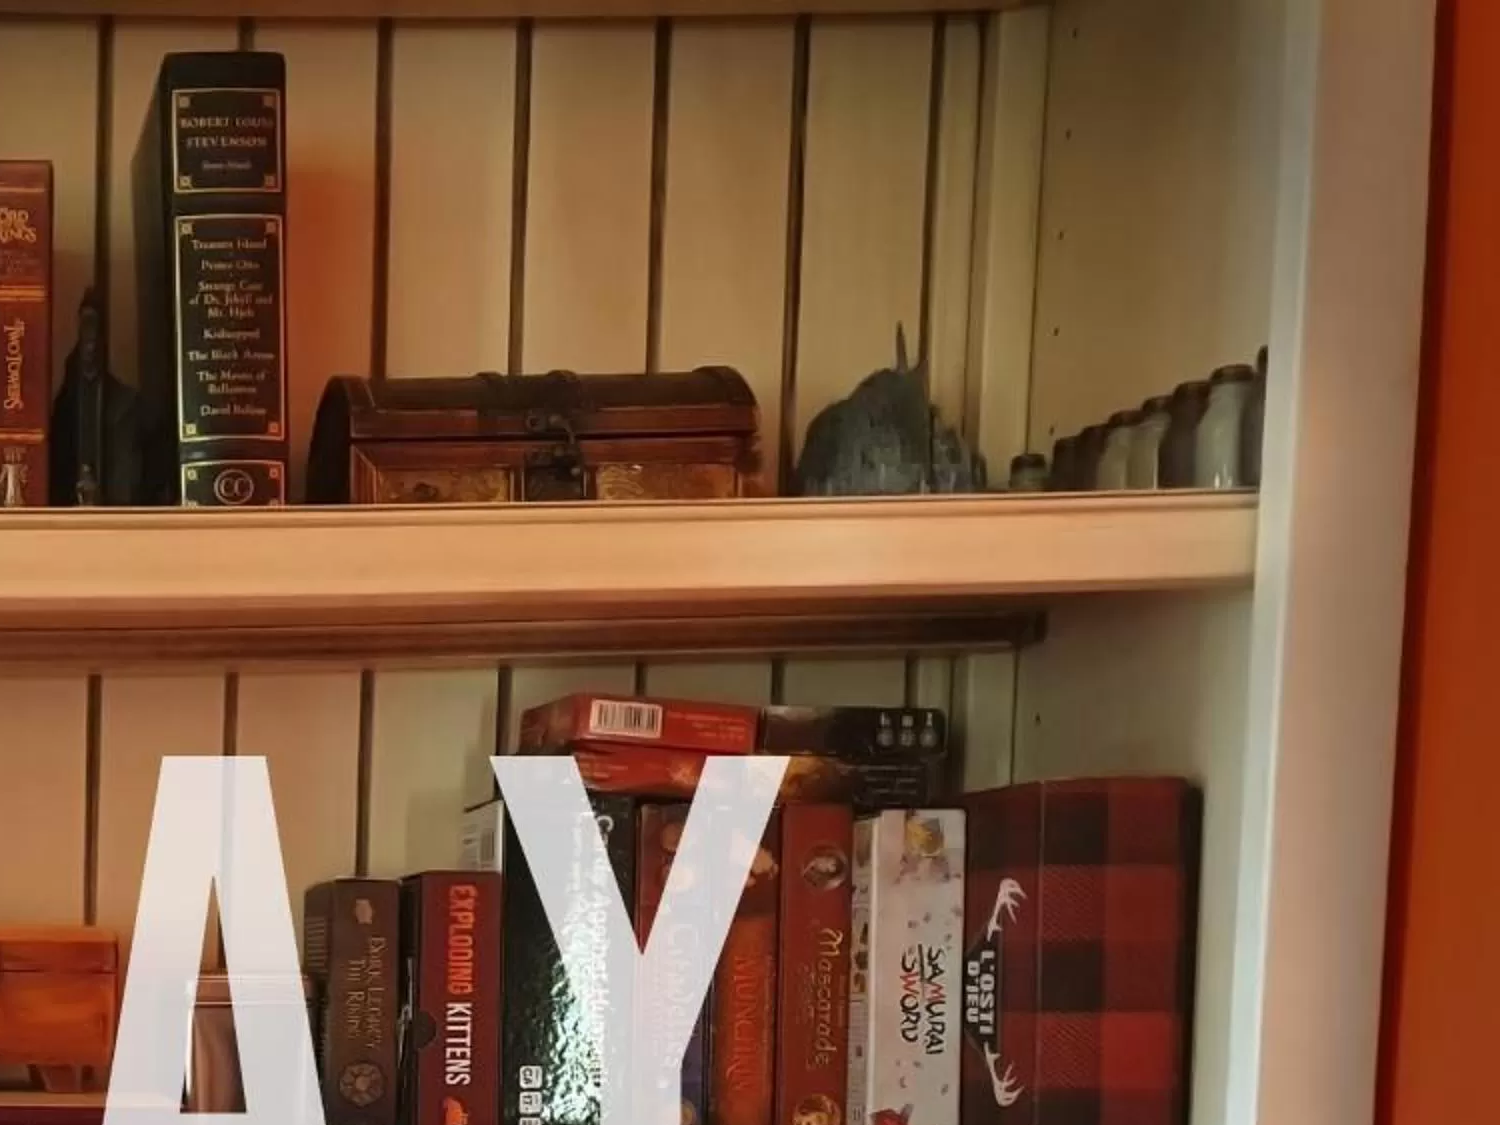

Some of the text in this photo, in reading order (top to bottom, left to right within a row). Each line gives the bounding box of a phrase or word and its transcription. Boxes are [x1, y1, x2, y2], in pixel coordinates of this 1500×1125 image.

[186, 136, 267, 148] STEVENSON
[448, 884, 477, 994] EXPLODING
[814, 927, 844, 1066] Mascarade
[900, 948, 922, 1044] SWORD
[923, 944, 948, 1056] SAMURAI
[964, 960, 981, 1024] D'JEU
[975, 948, 996, 1035] L'OSTI
[444, 1002, 475, 1087] KITTENS
